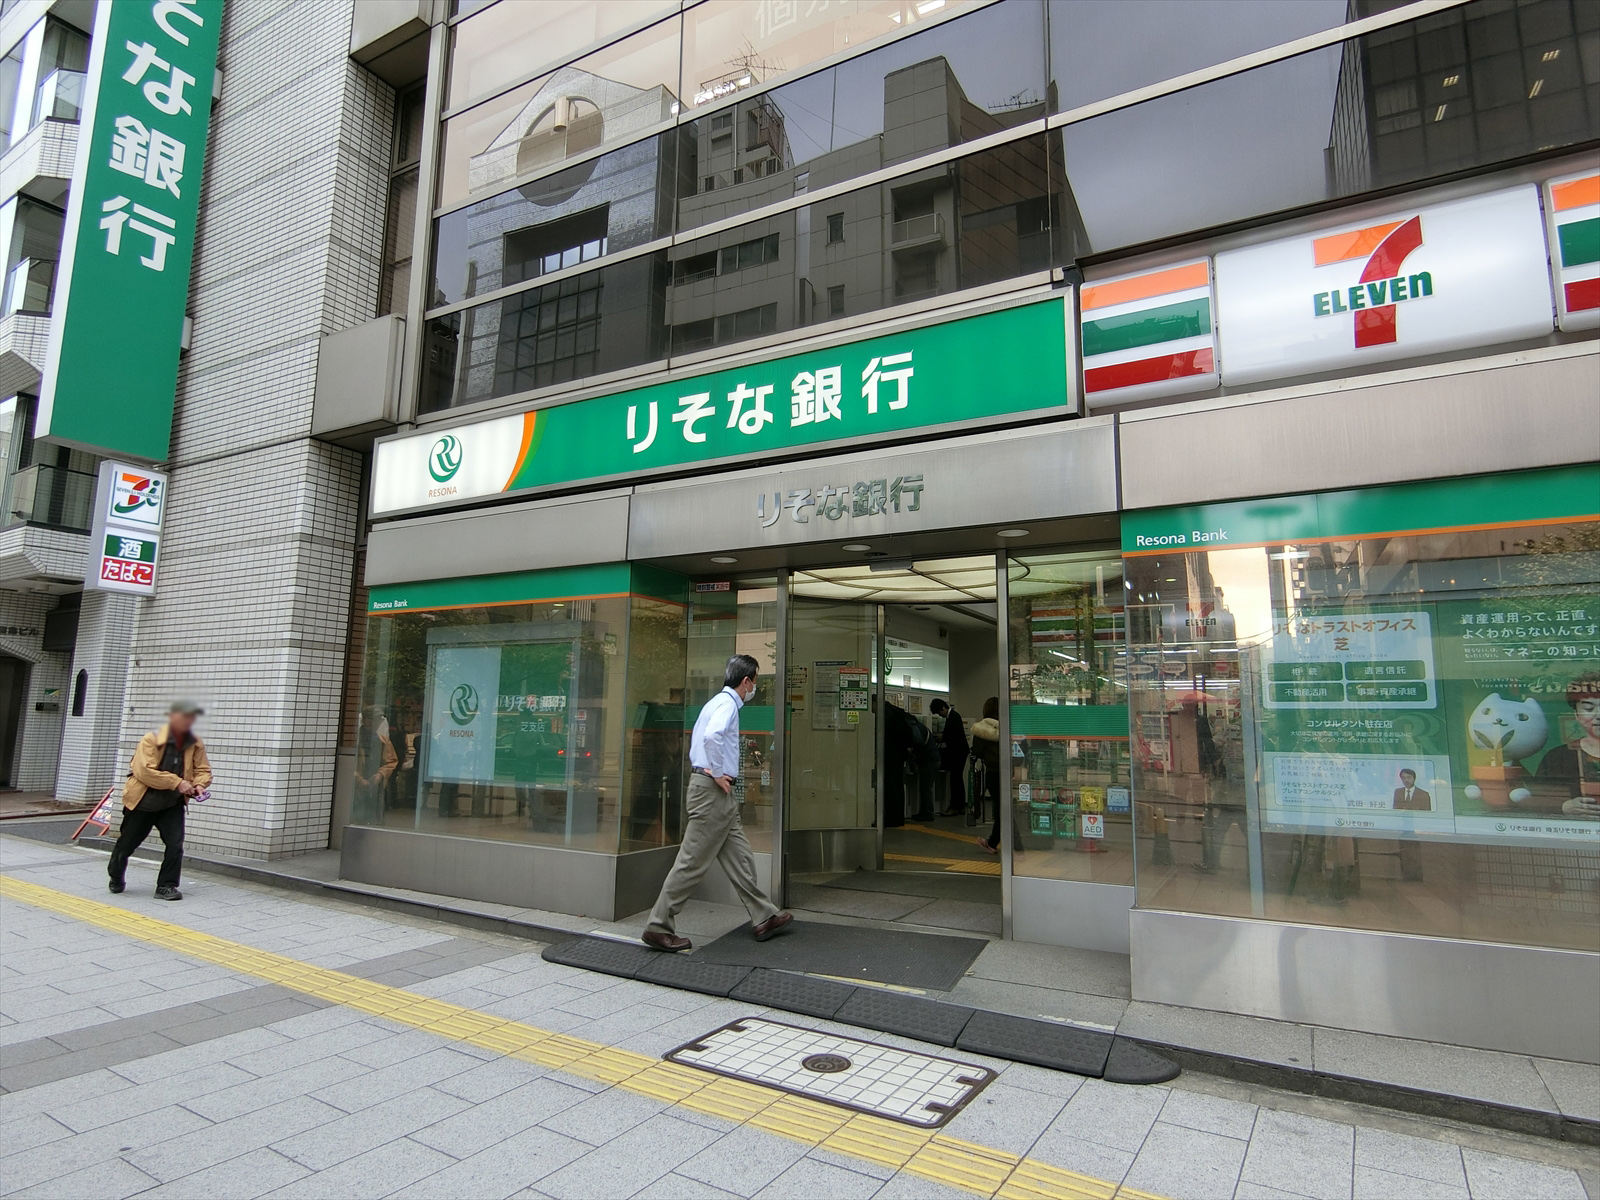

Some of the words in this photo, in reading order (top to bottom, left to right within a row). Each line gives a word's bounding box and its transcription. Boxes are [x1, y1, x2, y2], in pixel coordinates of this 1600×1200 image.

[626, 350, 915, 454] りそな銀行
[428, 486, 458, 498] RESONA
[757, 474, 925, 528] りそな銀行
[1136, 534, 1186, 547] Resona
[1192, 528, 1228, 543] Bank
[118, 538, 144, 559] 酒
[102, 559, 152, 584] たばこ
[373, 600, 393, 610] Resona
[393, 599, 408, 608] Bank
[1461, 609, 1593, 625] 資産運用って、正直、
[1462, 623, 1598, 639] よくわからないんです
[1333, 637, 1350, 651] 芝
[1363, 665, 1407, 675] 遺言信託
[1284, 687, 1328, 697] 不動産活用
[520, 721, 547, 733] 芝支店
[1306, 719, 1394, 729] コンサルタント駐在店
[449, 729, 475, 738] RESONA
[1084, 825, 1102, 834] AED
